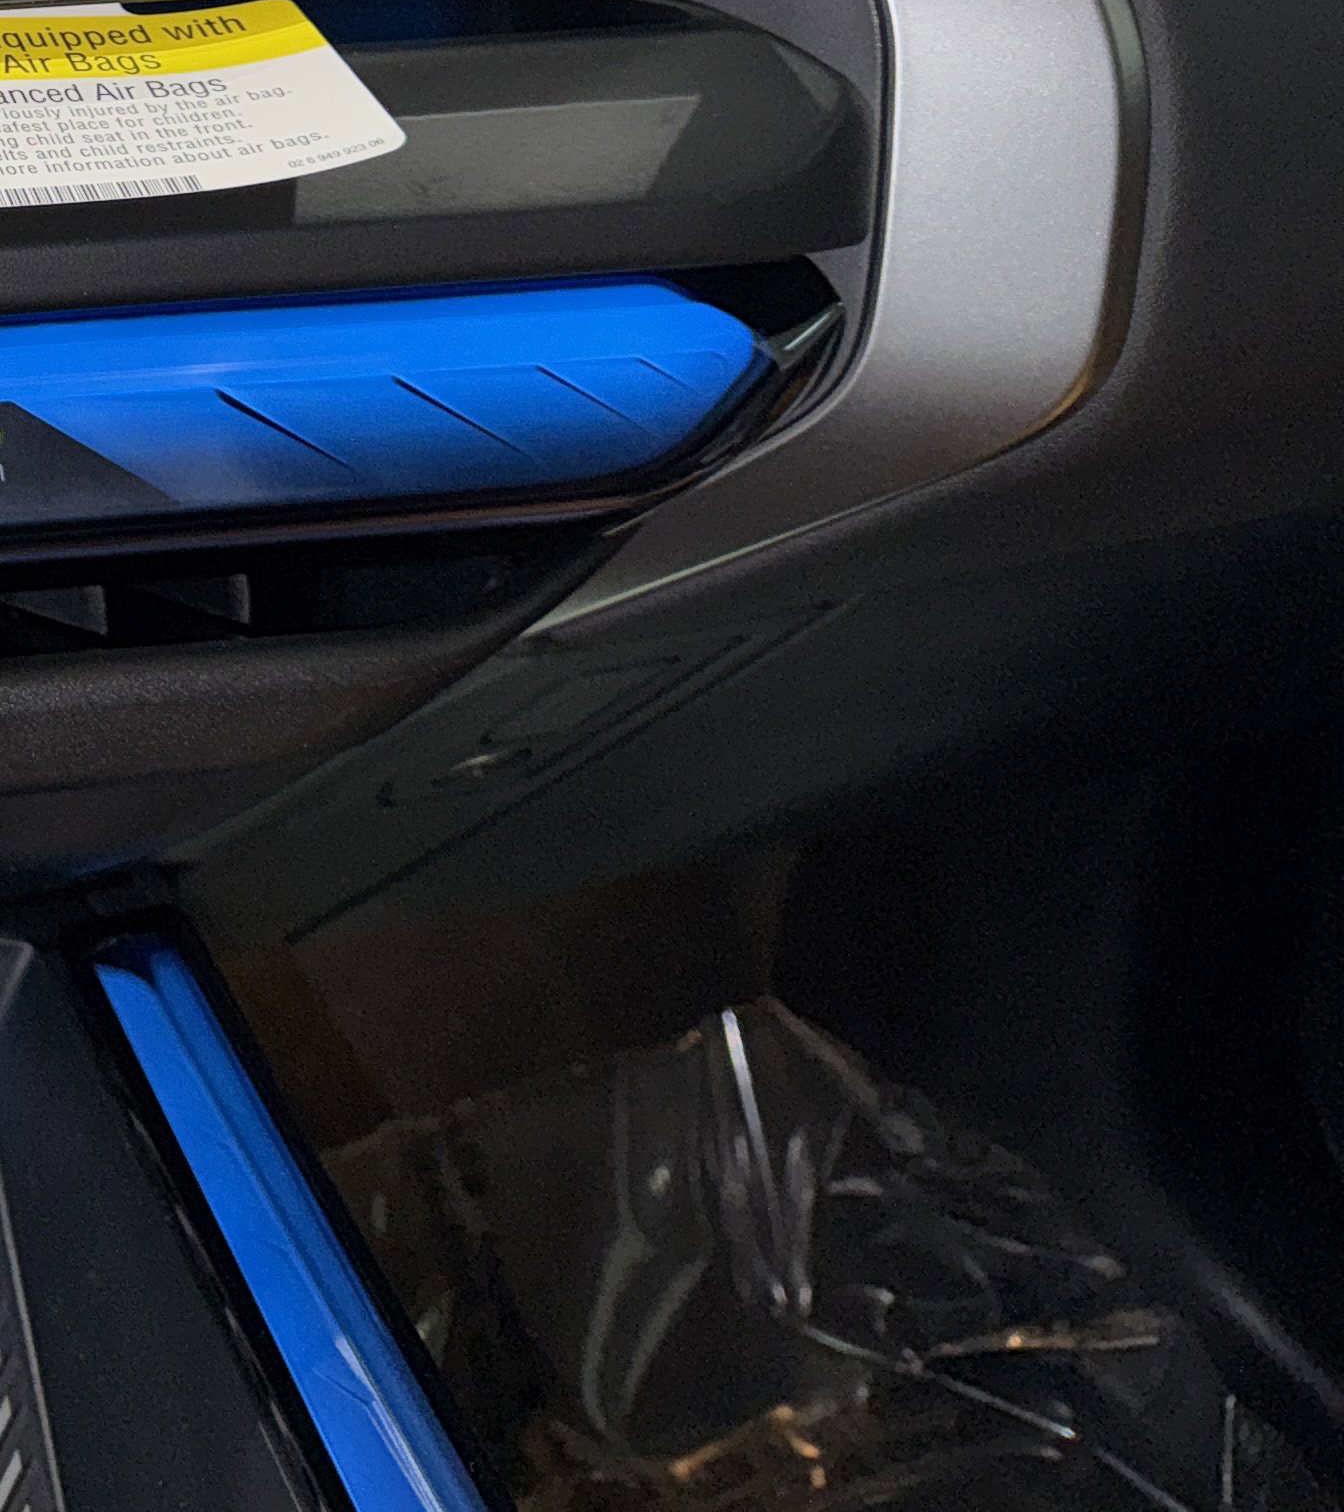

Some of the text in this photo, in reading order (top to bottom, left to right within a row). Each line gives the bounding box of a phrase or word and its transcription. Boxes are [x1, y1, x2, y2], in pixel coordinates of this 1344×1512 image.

[161, 16, 246, 40] with
[3, 53, 52, 74] Air
[65, 52, 162, 75] Bags
[96, 82, 135, 101] Air
[144, 78, 227, 98] Bags
[68, 104, 139, 119] injured
[144, 101, 168, 115] by
[175, 99, 207, 110] the
[215, 94, 239, 106] air
[247, 87, 293, 101] bag.
[26, 131, 74, 146] child
[81, 131, 122, 143] seat
[130, 129, 149, 140] in
[154, 127, 187, 139] the
[194, 119, 253, 136] front.
[58, 120, 108, 133] place
[116, 116, 144, 128] for
[153, 108, 243, 126] children.
[36, 146, 73, 159] and
[80, 144, 128, 157] child
[137, 136, 242, 153] restraints.
[46, 156, 166, 173] information
[173, 148, 232, 164] about
[239, 144, 264, 155] air
[269, 131, 330, 150] bags.
